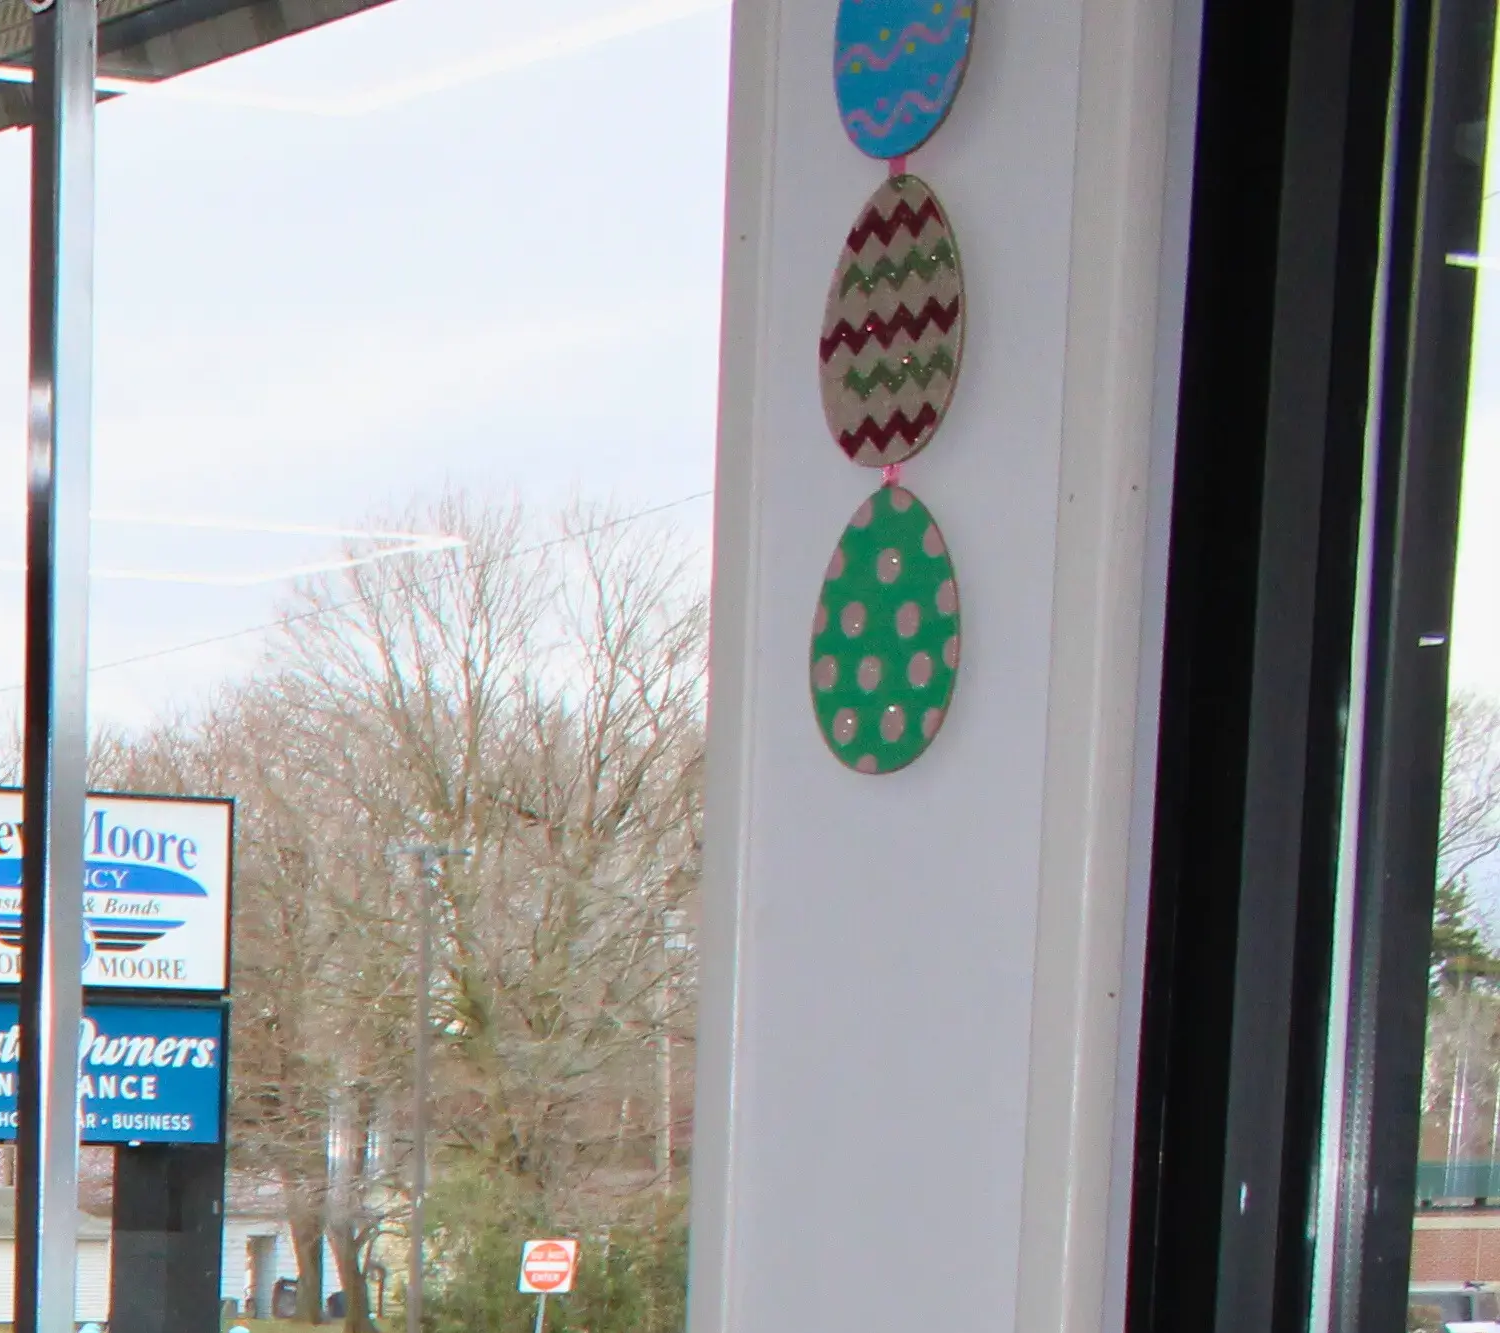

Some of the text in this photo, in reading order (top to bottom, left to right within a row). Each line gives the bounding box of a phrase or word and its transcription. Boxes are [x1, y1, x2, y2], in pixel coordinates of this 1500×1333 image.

[104, 898, 160, 916] Bonds
[97, 955, 188, 981] MOORE
[80, 1113, 98, 1129] AR
[112, 1113, 191, 1131] BUSINESS
